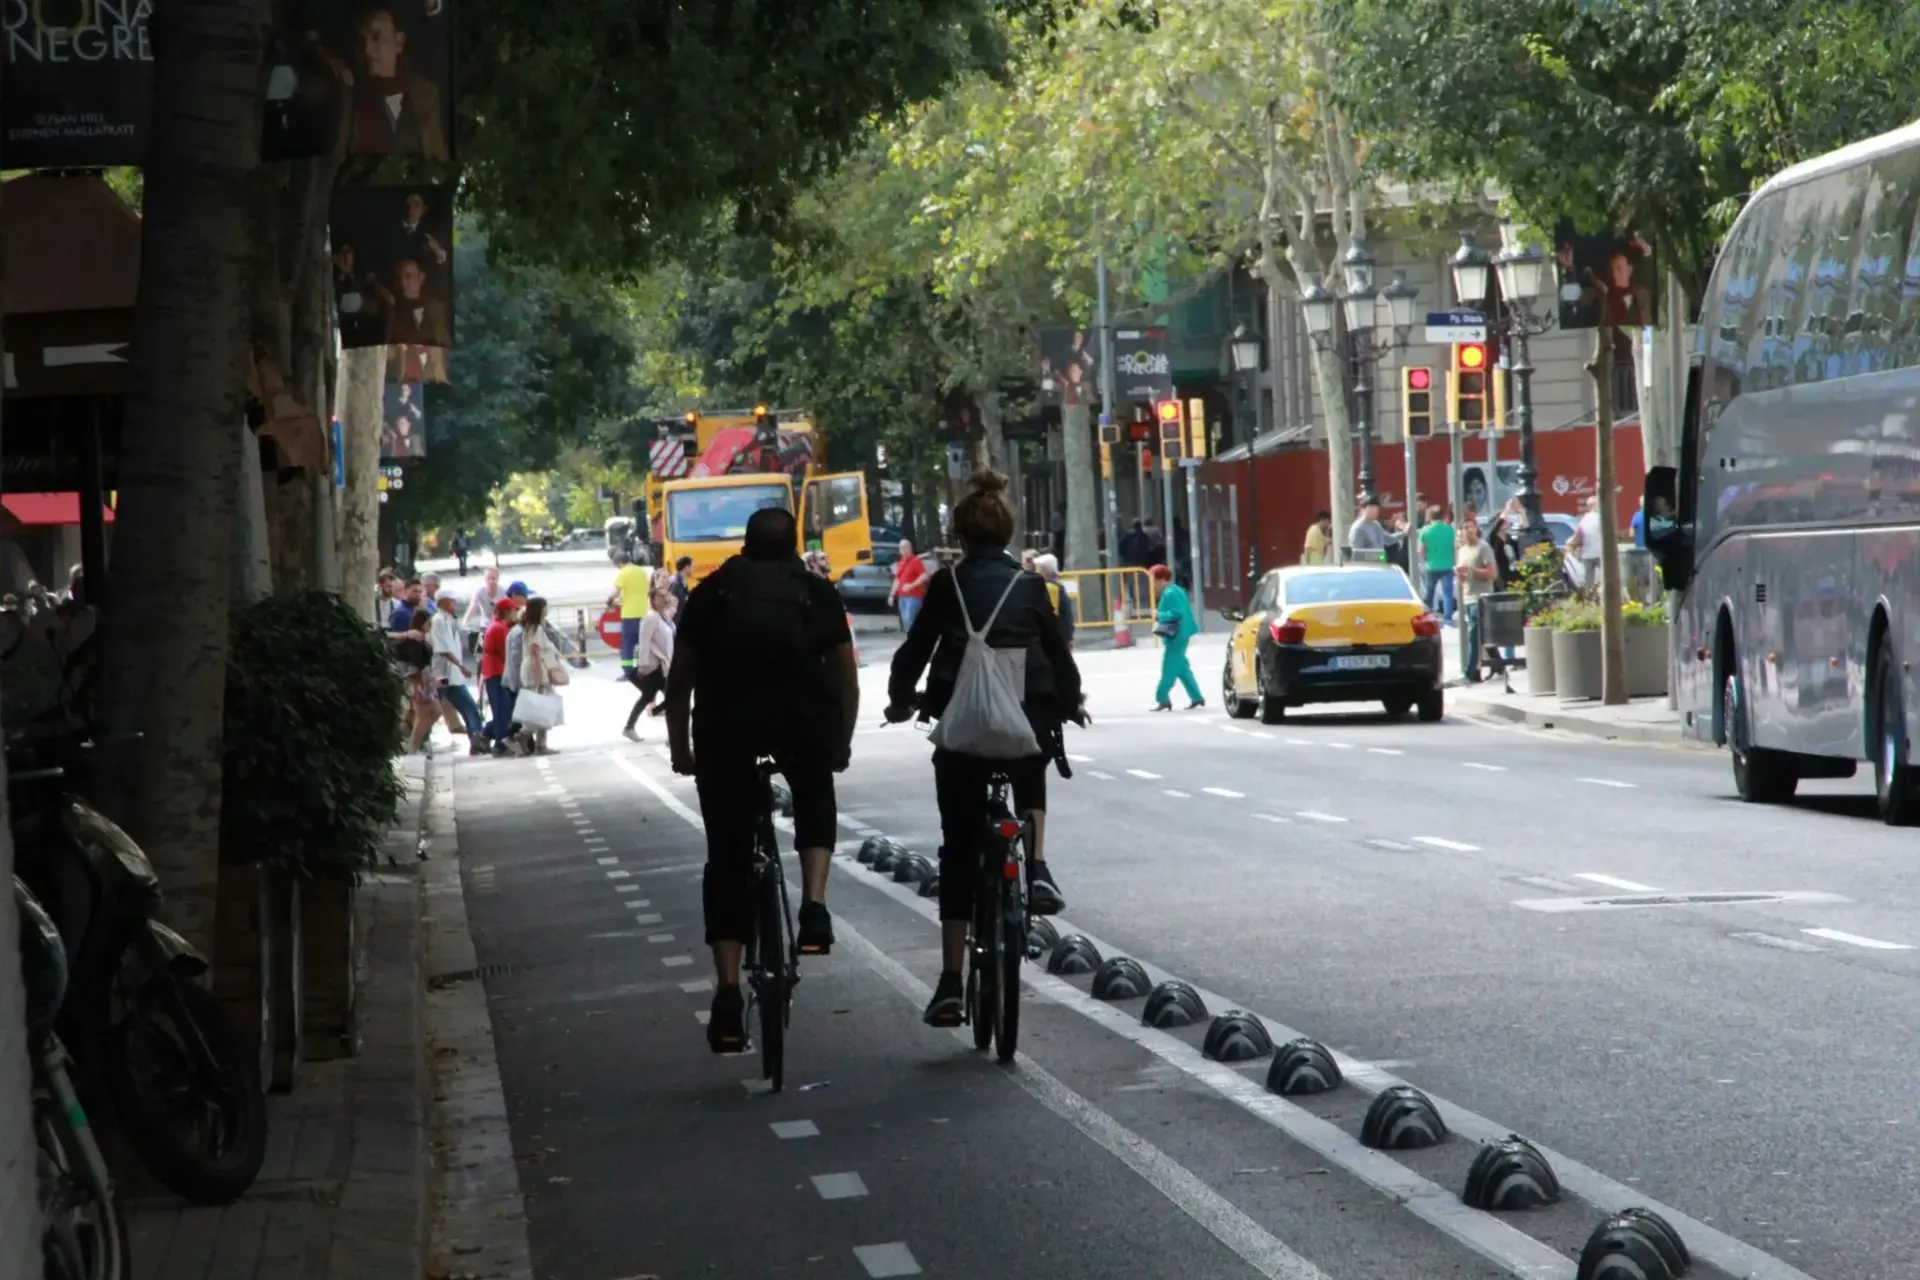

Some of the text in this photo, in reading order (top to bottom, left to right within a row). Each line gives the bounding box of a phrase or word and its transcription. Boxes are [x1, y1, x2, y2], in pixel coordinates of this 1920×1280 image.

[9, 25, 155, 63] NEGRE
[35, 111, 106, 126] SUSAN HILL
[8, 127, 60, 141] STEPHEN
